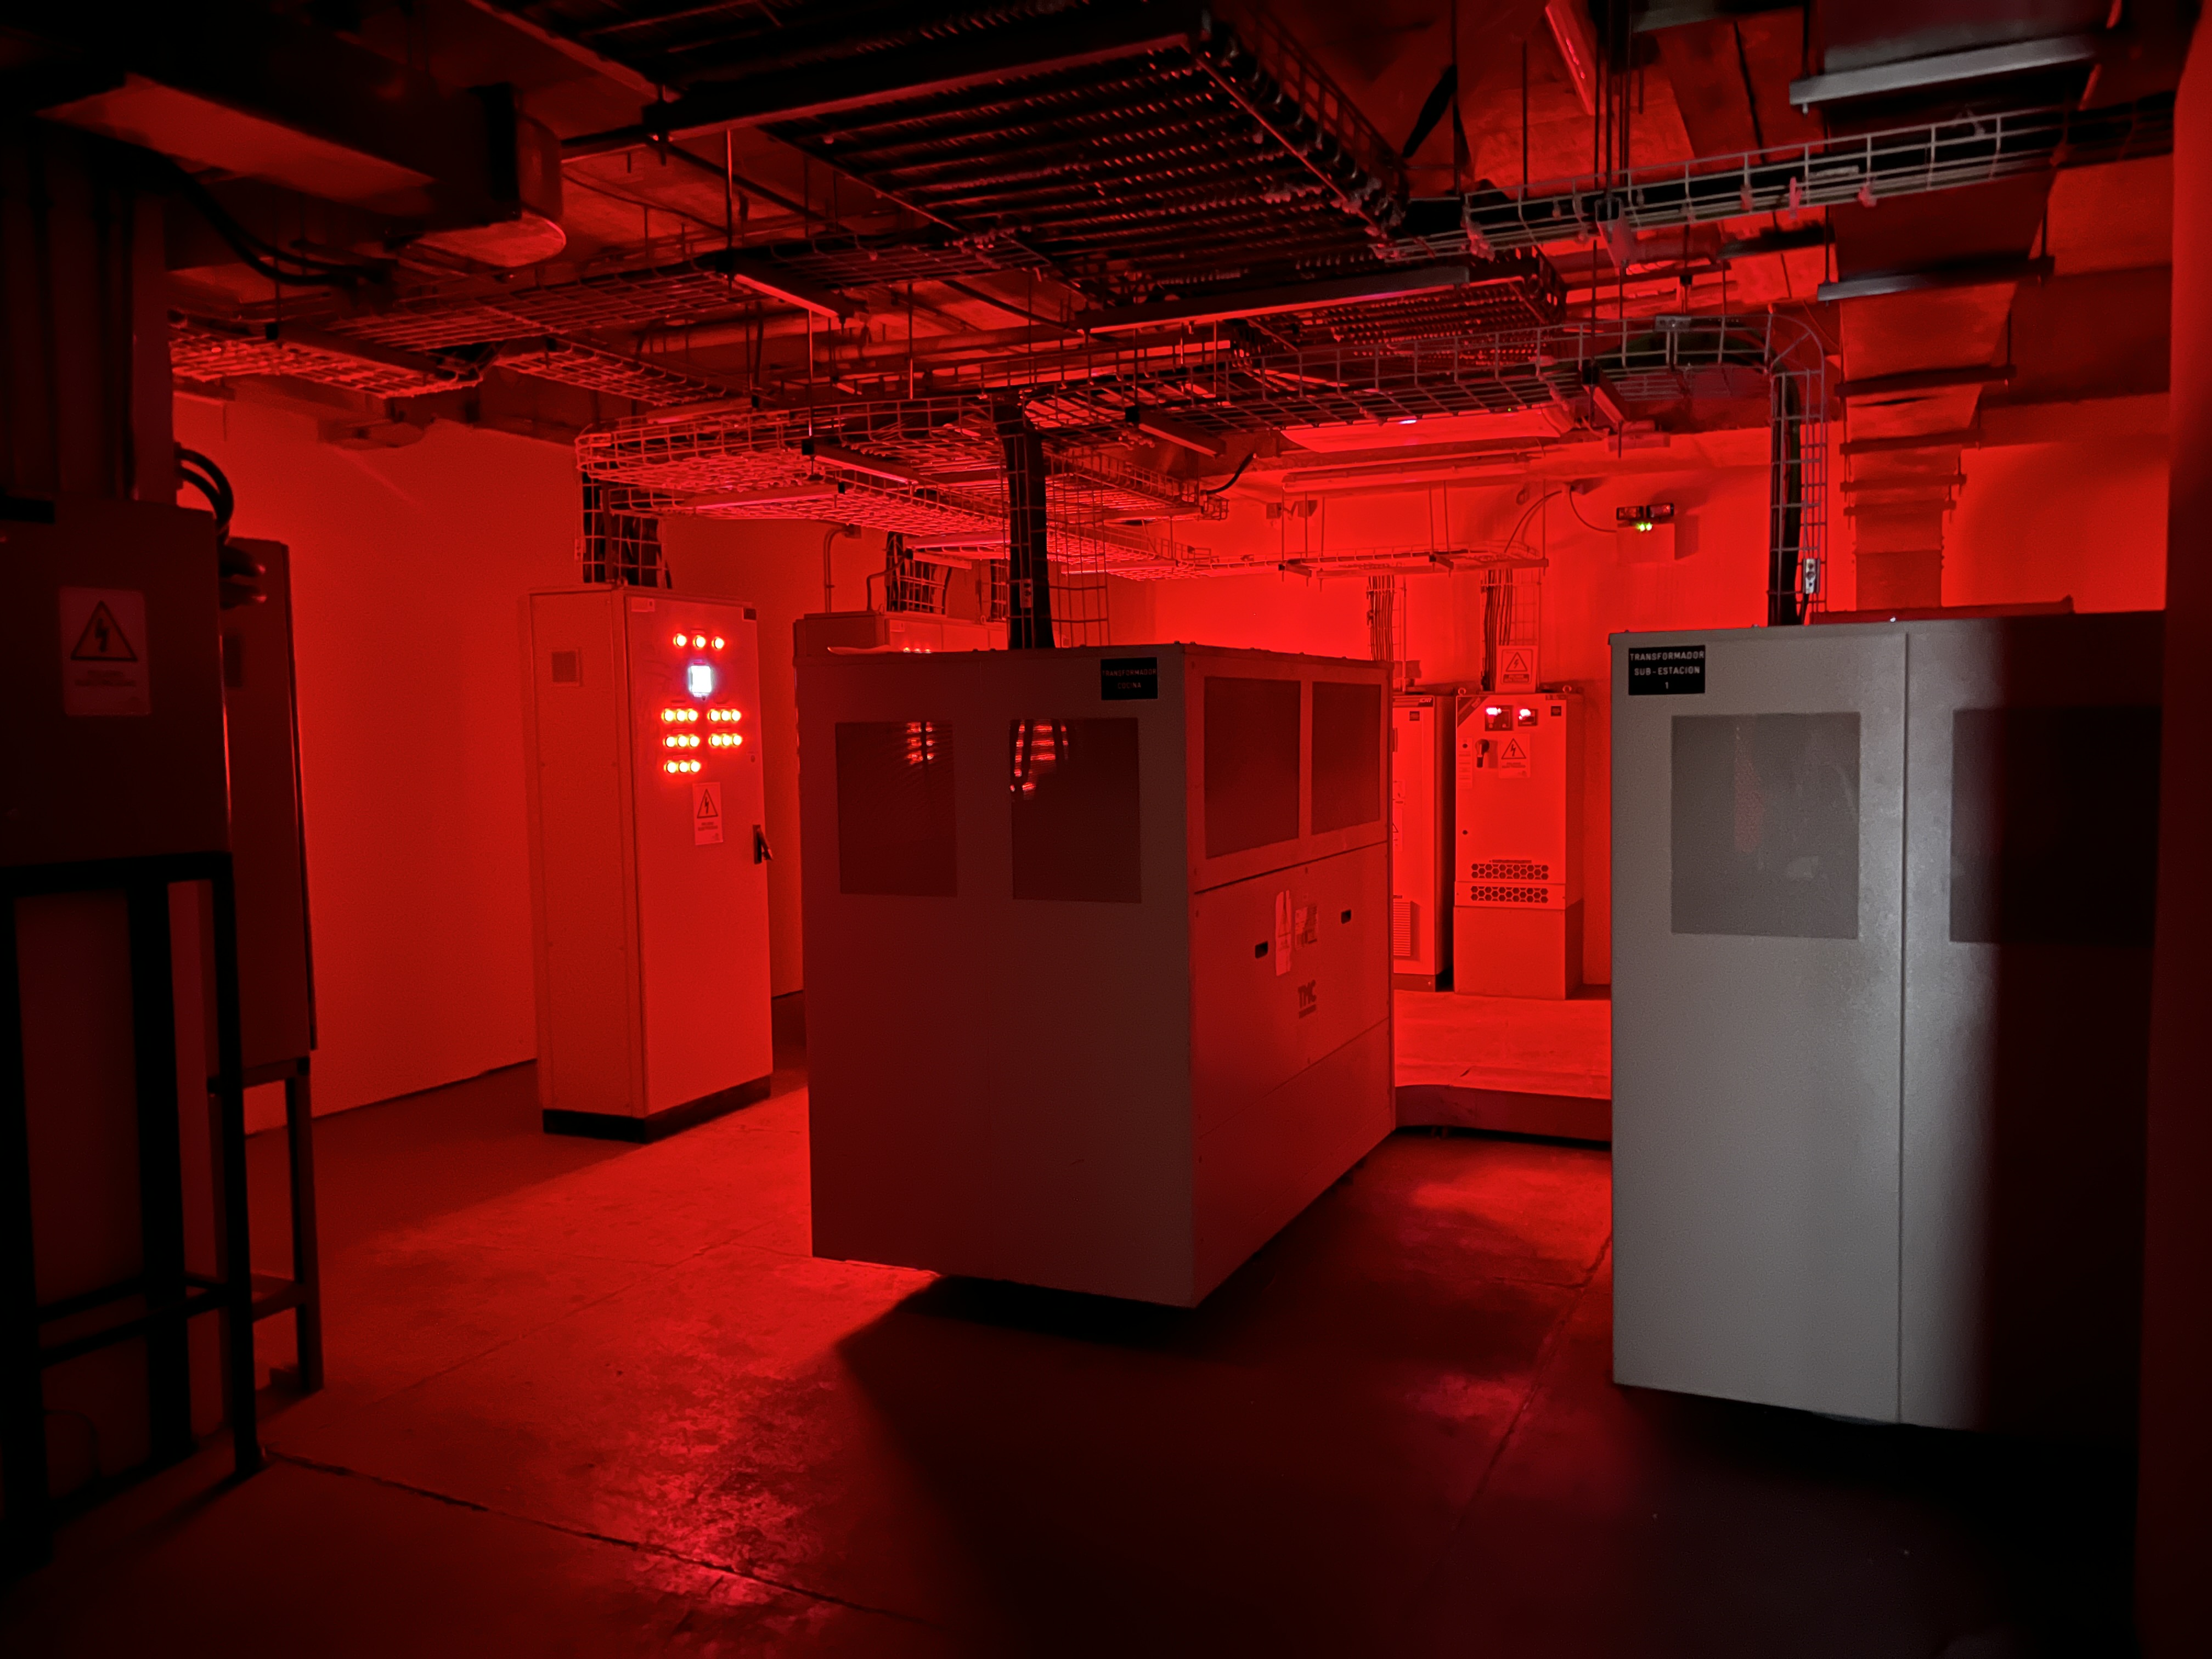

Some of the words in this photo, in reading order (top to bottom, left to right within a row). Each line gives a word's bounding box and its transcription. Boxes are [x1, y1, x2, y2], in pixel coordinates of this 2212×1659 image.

[1630, 651, 1705, 661] TRANSFORMADOR
[1102, 669, 1156, 677] TRANSFORMADOR
[1634, 666, 1700, 676] SUB-ESTACION
[1117, 681, 1142, 690] COCINA
[1664, 681, 1669, 690] 1
